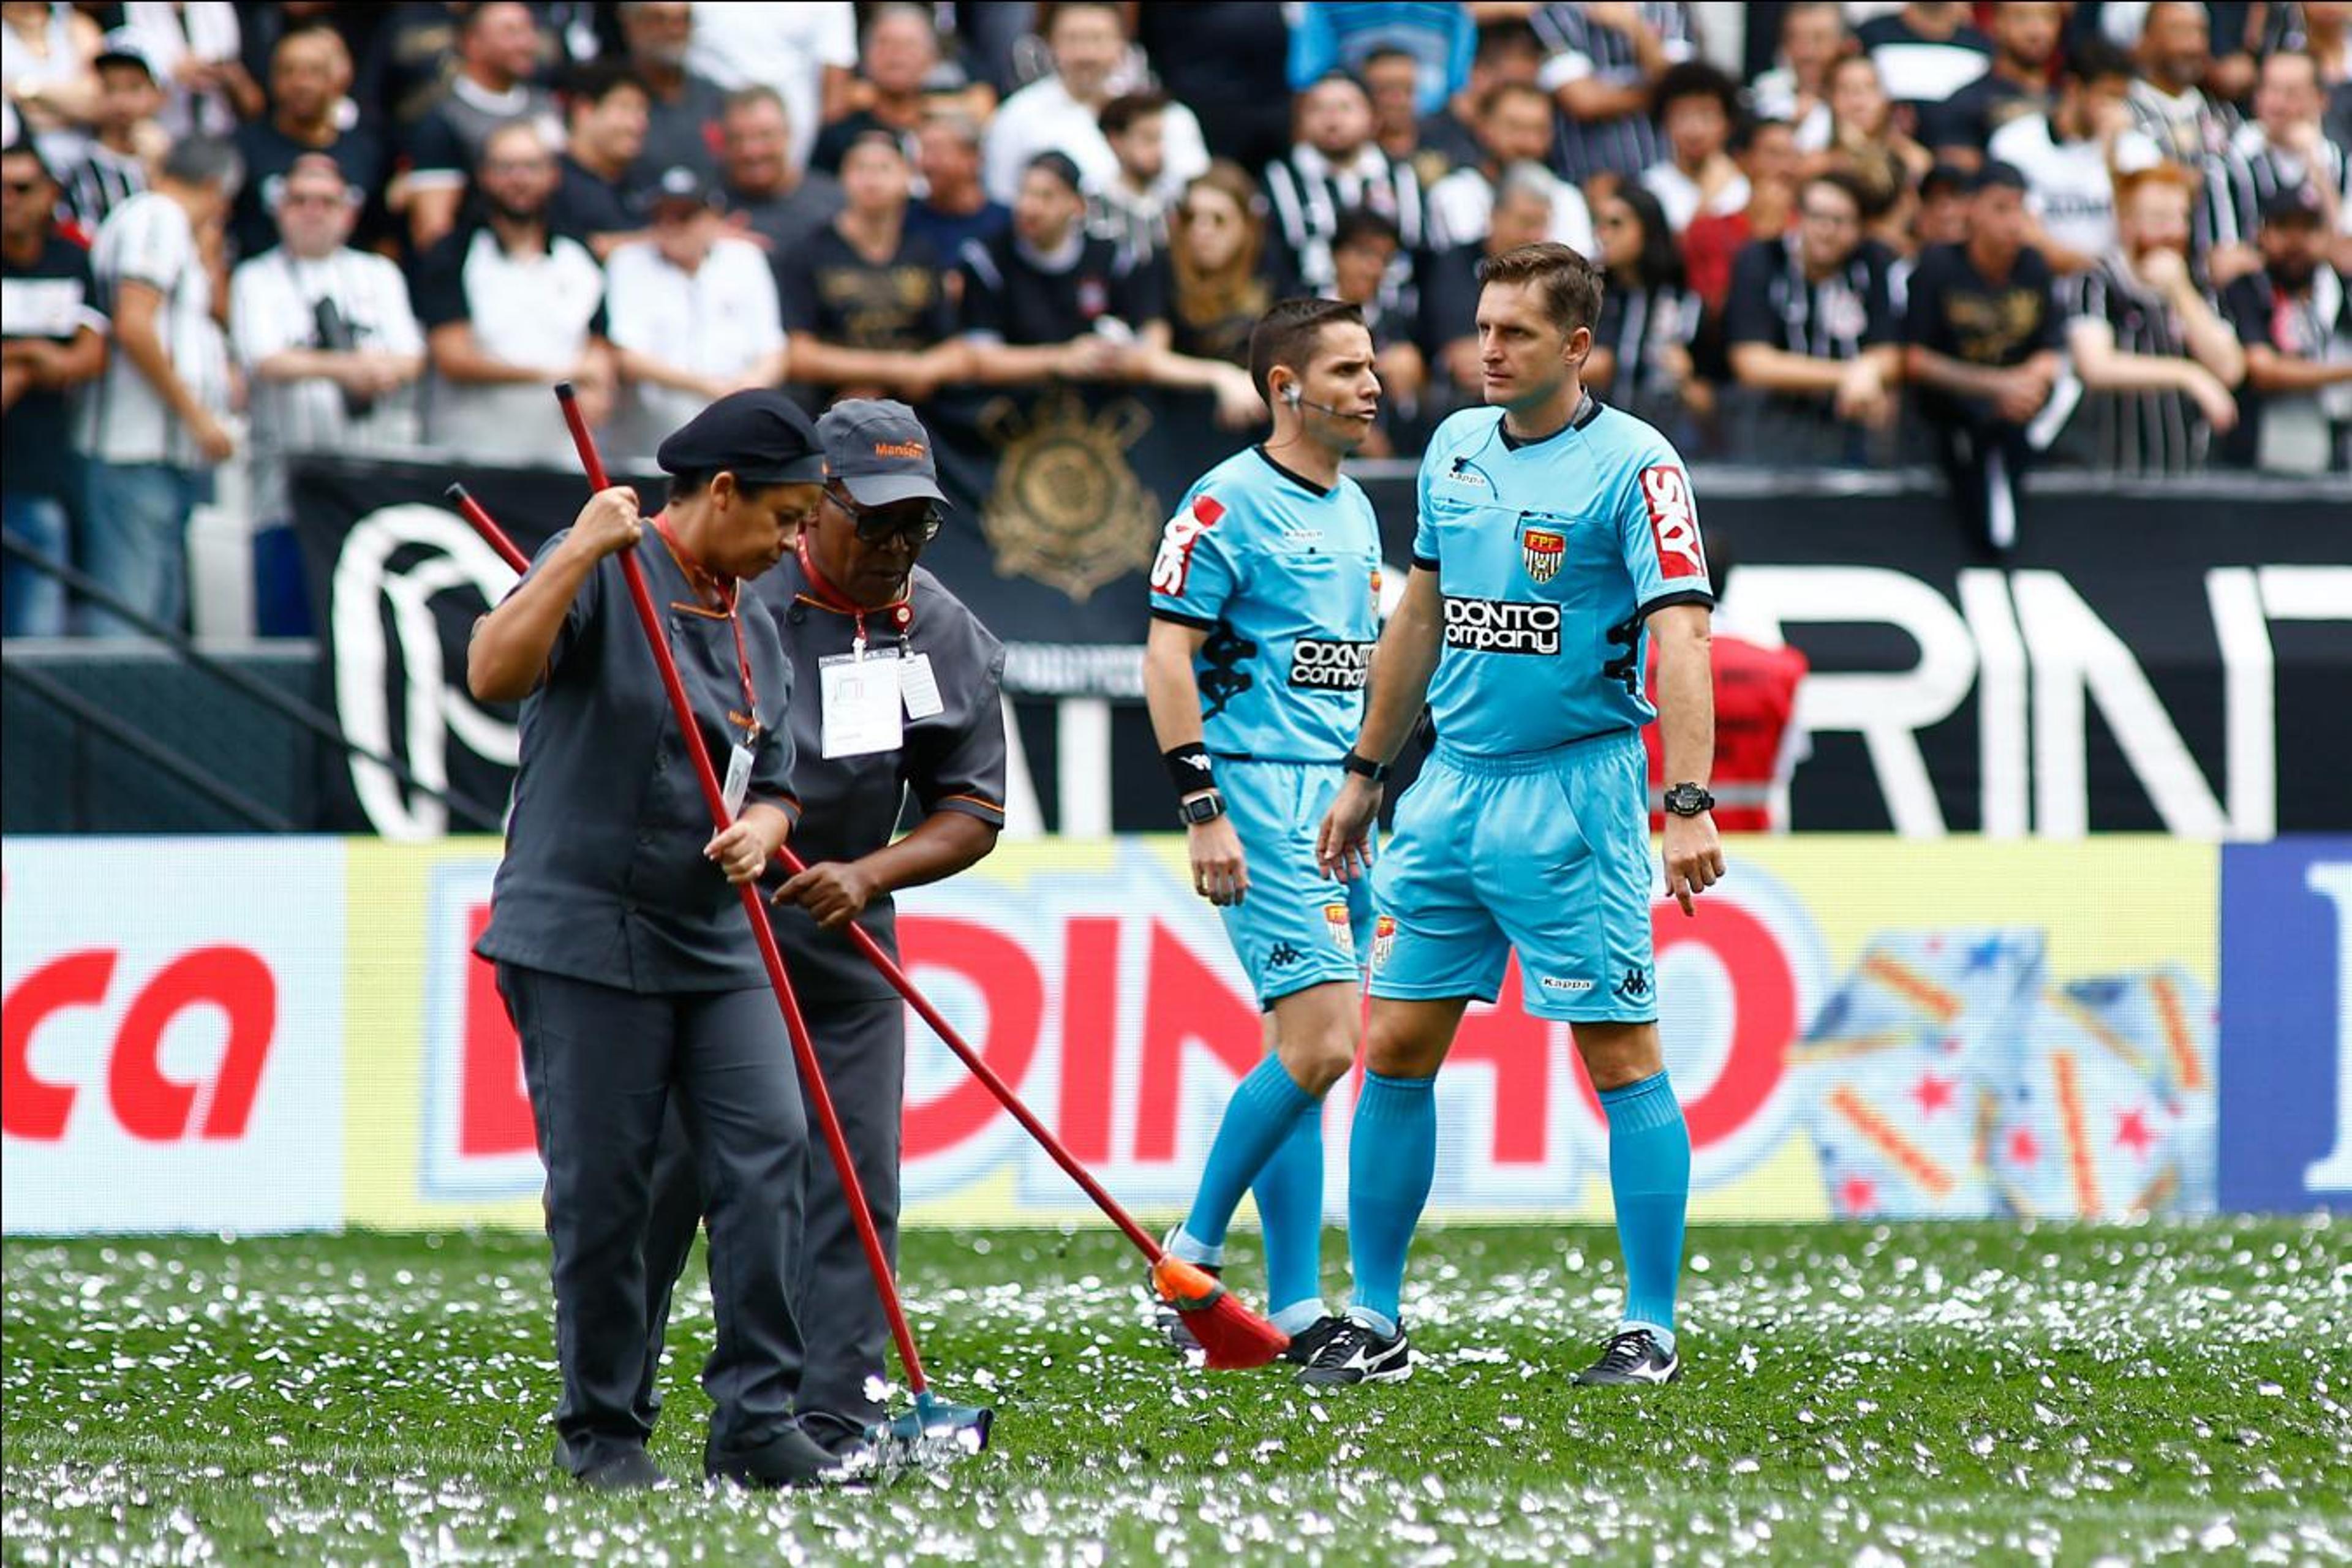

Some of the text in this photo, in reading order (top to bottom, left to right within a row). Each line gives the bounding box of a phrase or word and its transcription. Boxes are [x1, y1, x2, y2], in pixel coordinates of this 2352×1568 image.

[1646, 469, 1703, 577] SKY
[1529, 533, 1559, 550] FPF
[1444, 599, 1560, 631] DONTO
[1294, 640, 1379, 668] ODONT
[1446, 624, 1559, 654] ompany
[1545, 978, 1589, 989] Kappa
[2, 944, 279, 1142] ca
[461, 897, 1797, 1161] DINHO
